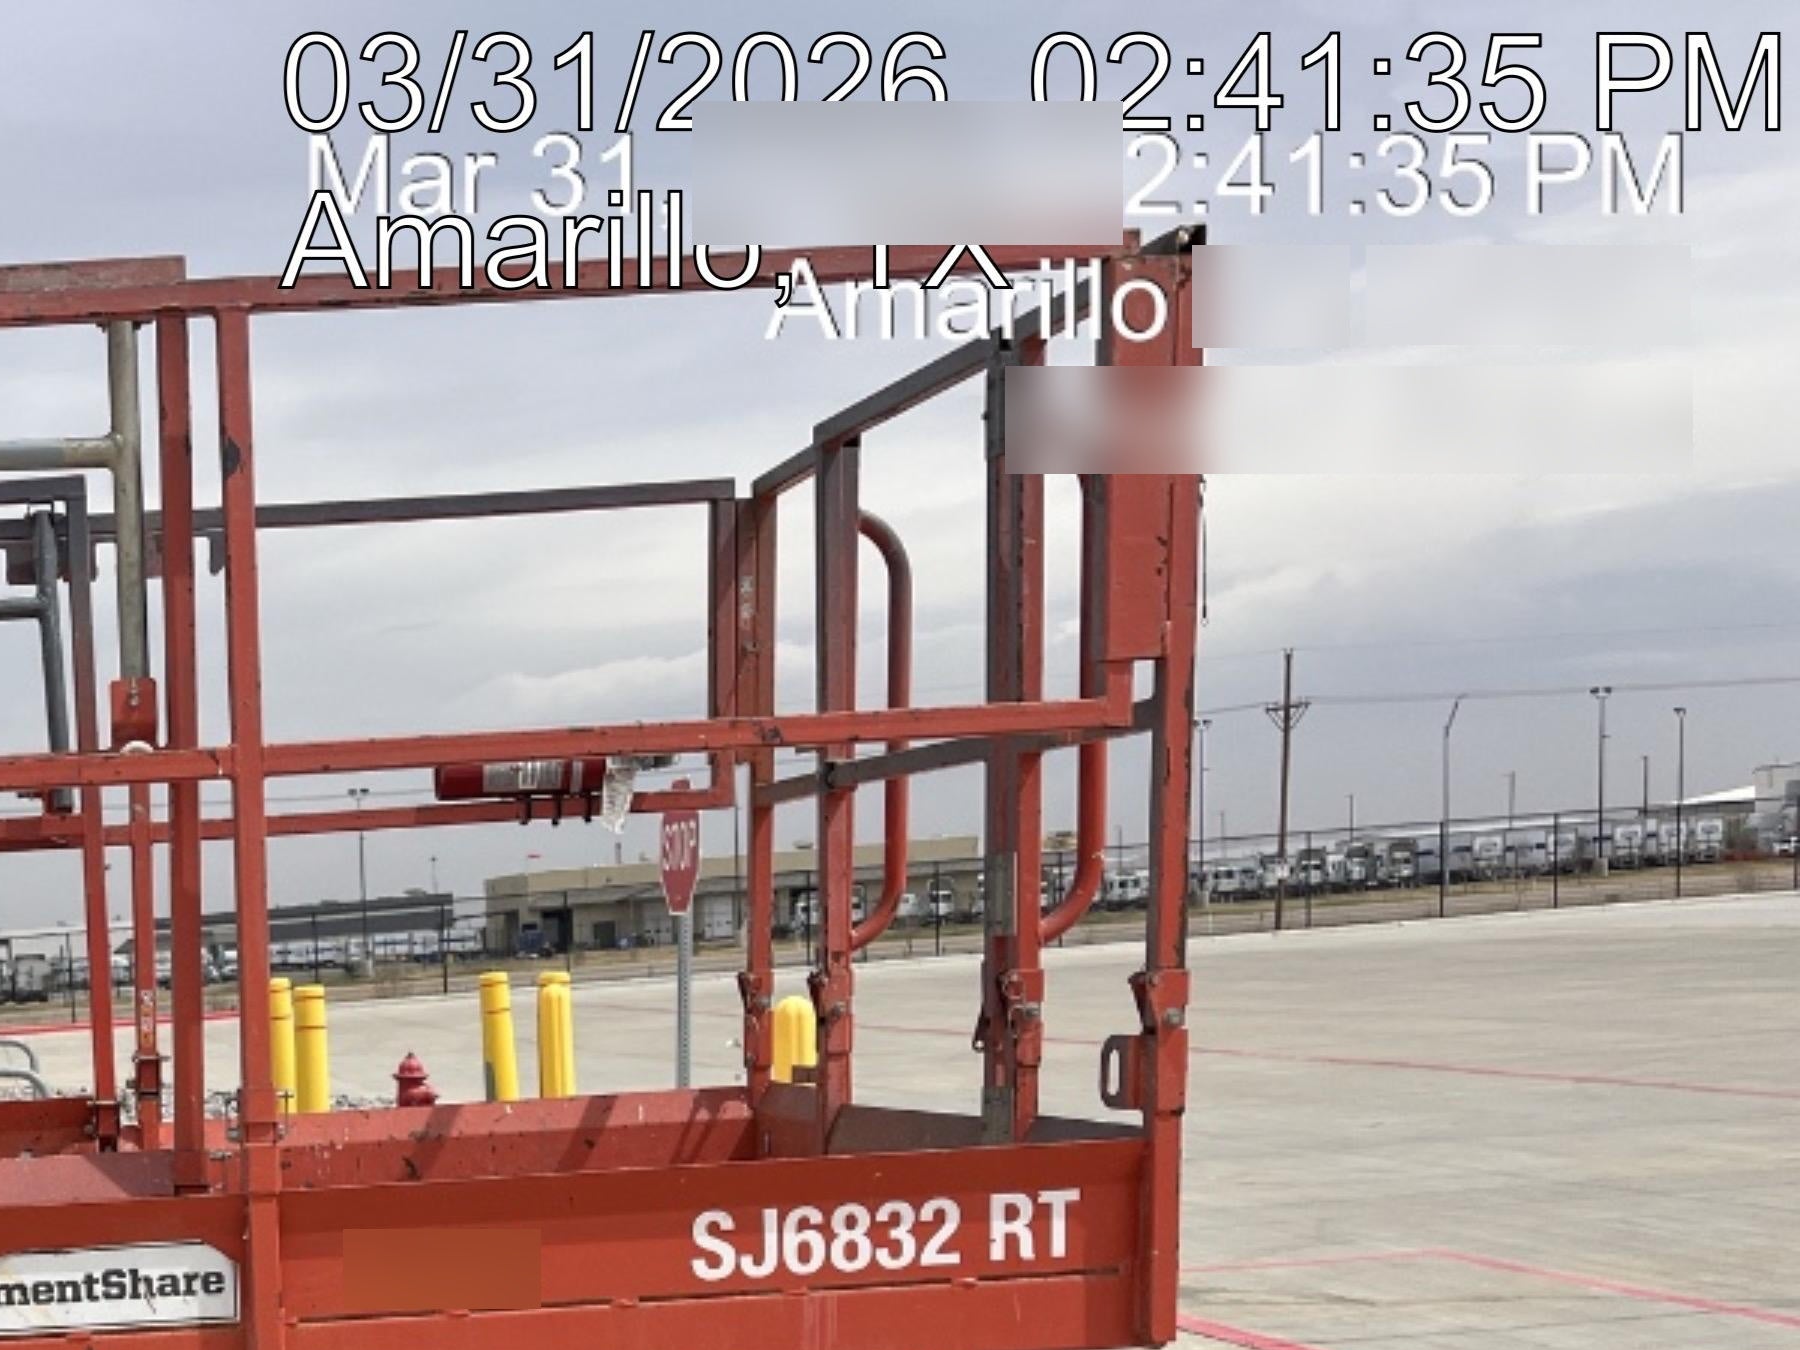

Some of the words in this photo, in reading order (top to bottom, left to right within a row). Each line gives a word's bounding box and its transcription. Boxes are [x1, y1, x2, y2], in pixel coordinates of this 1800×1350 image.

[663, 820, 697, 872] STOP
[690, 1196, 962, 1282] SJ6832
[988, 1187, 1081, 1262] RT
